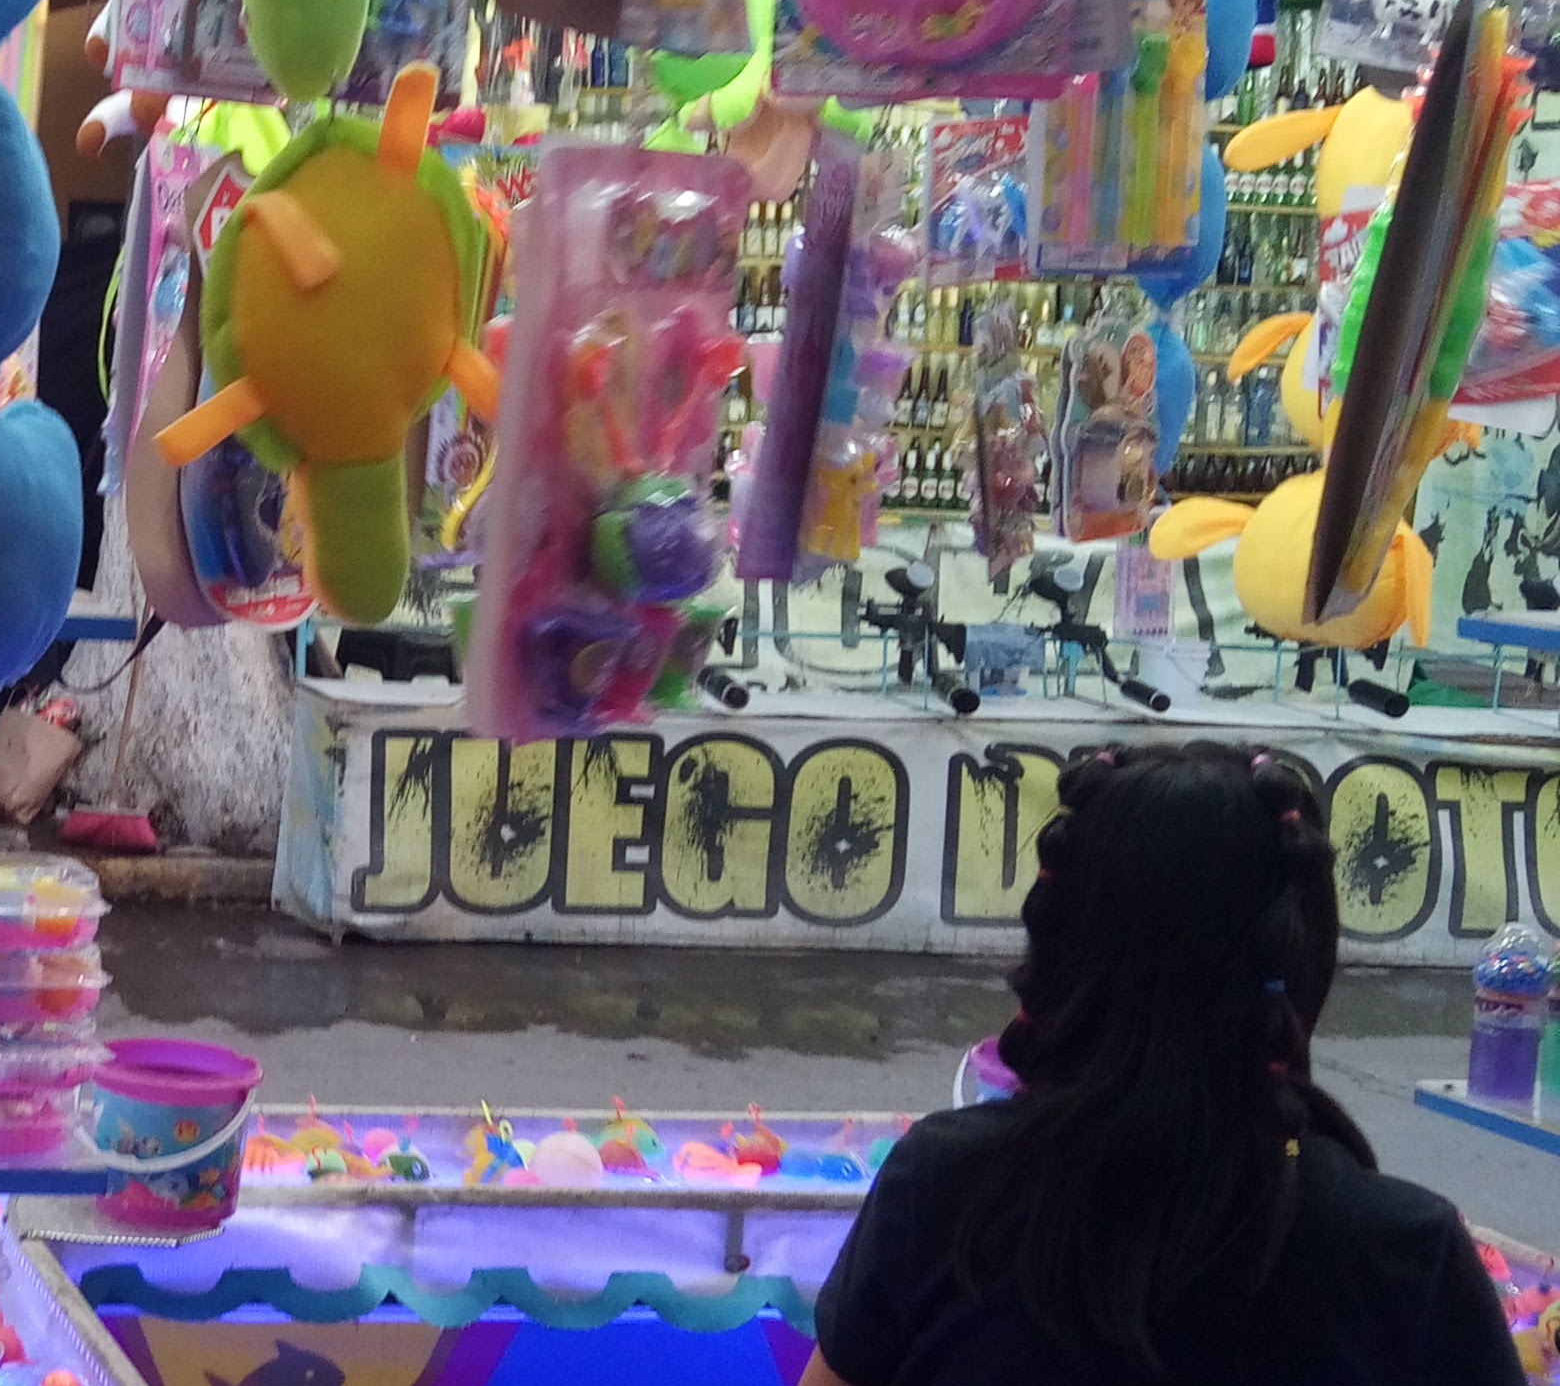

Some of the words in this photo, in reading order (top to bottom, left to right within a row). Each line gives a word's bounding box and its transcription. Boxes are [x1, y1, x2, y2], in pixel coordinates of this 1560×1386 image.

[350, 729, 910, 927] JUEGO
[941, 742, 1130, 926] D
[1268, 746, 1560, 944] OT
